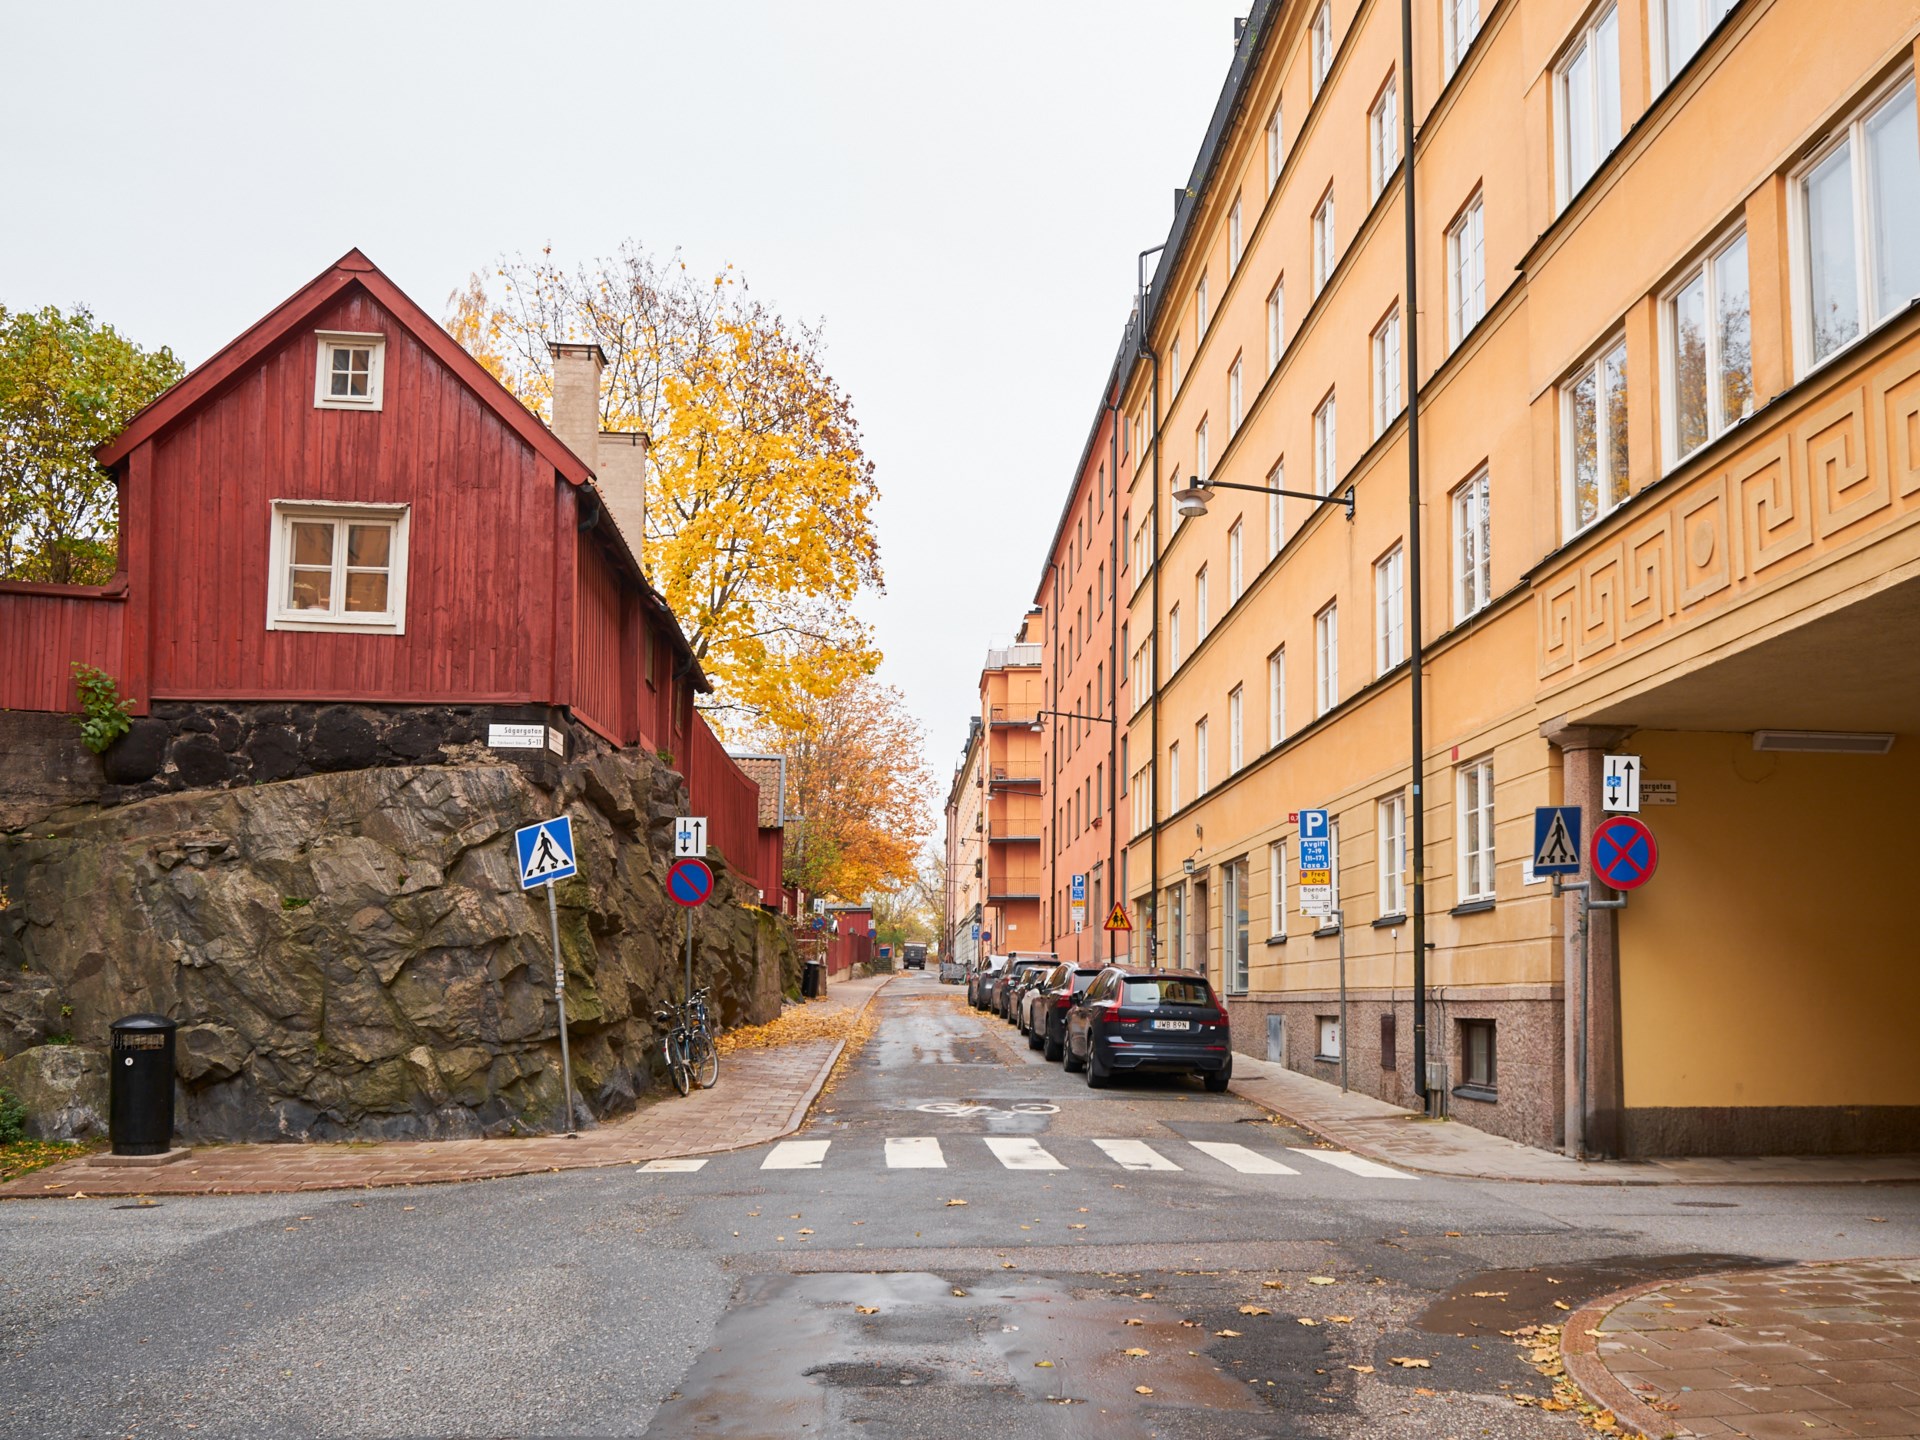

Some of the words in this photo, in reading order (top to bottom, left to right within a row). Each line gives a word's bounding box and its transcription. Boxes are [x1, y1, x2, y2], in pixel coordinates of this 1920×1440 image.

[527, 738, 542, 746] 5-11
[1640, 783, 1671, 792] gargatan
[1306, 812, 1323, 836] P
[1075, 875, 1082, 886] P
[1173, 1021, 1187, 1029] 89N
